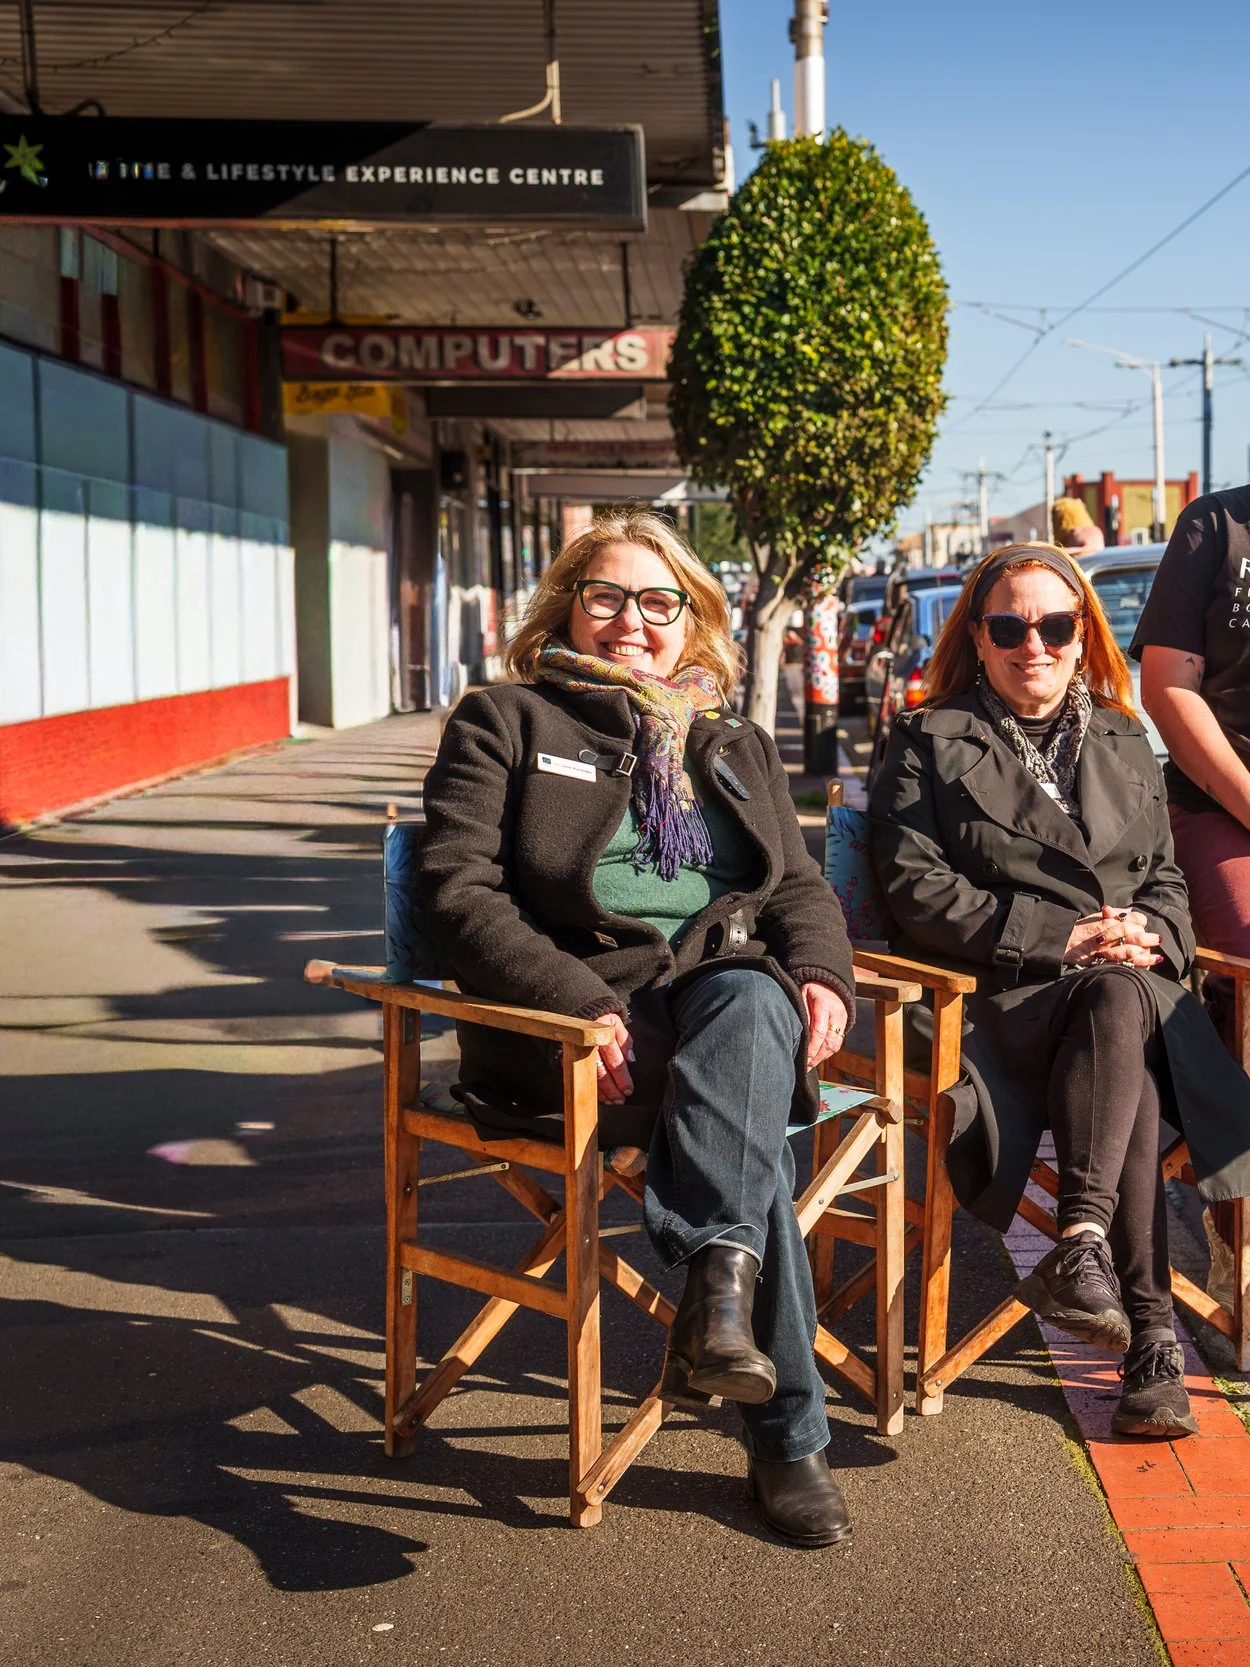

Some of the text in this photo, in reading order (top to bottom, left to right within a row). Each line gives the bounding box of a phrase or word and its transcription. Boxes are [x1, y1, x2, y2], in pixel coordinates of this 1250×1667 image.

[206, 163, 336, 182] LIFESTYLE
[345, 165, 500, 185] EXPERIENCE
[508, 168, 605, 186] CENTRE
[320, 332, 650, 372] COMPUTERS
